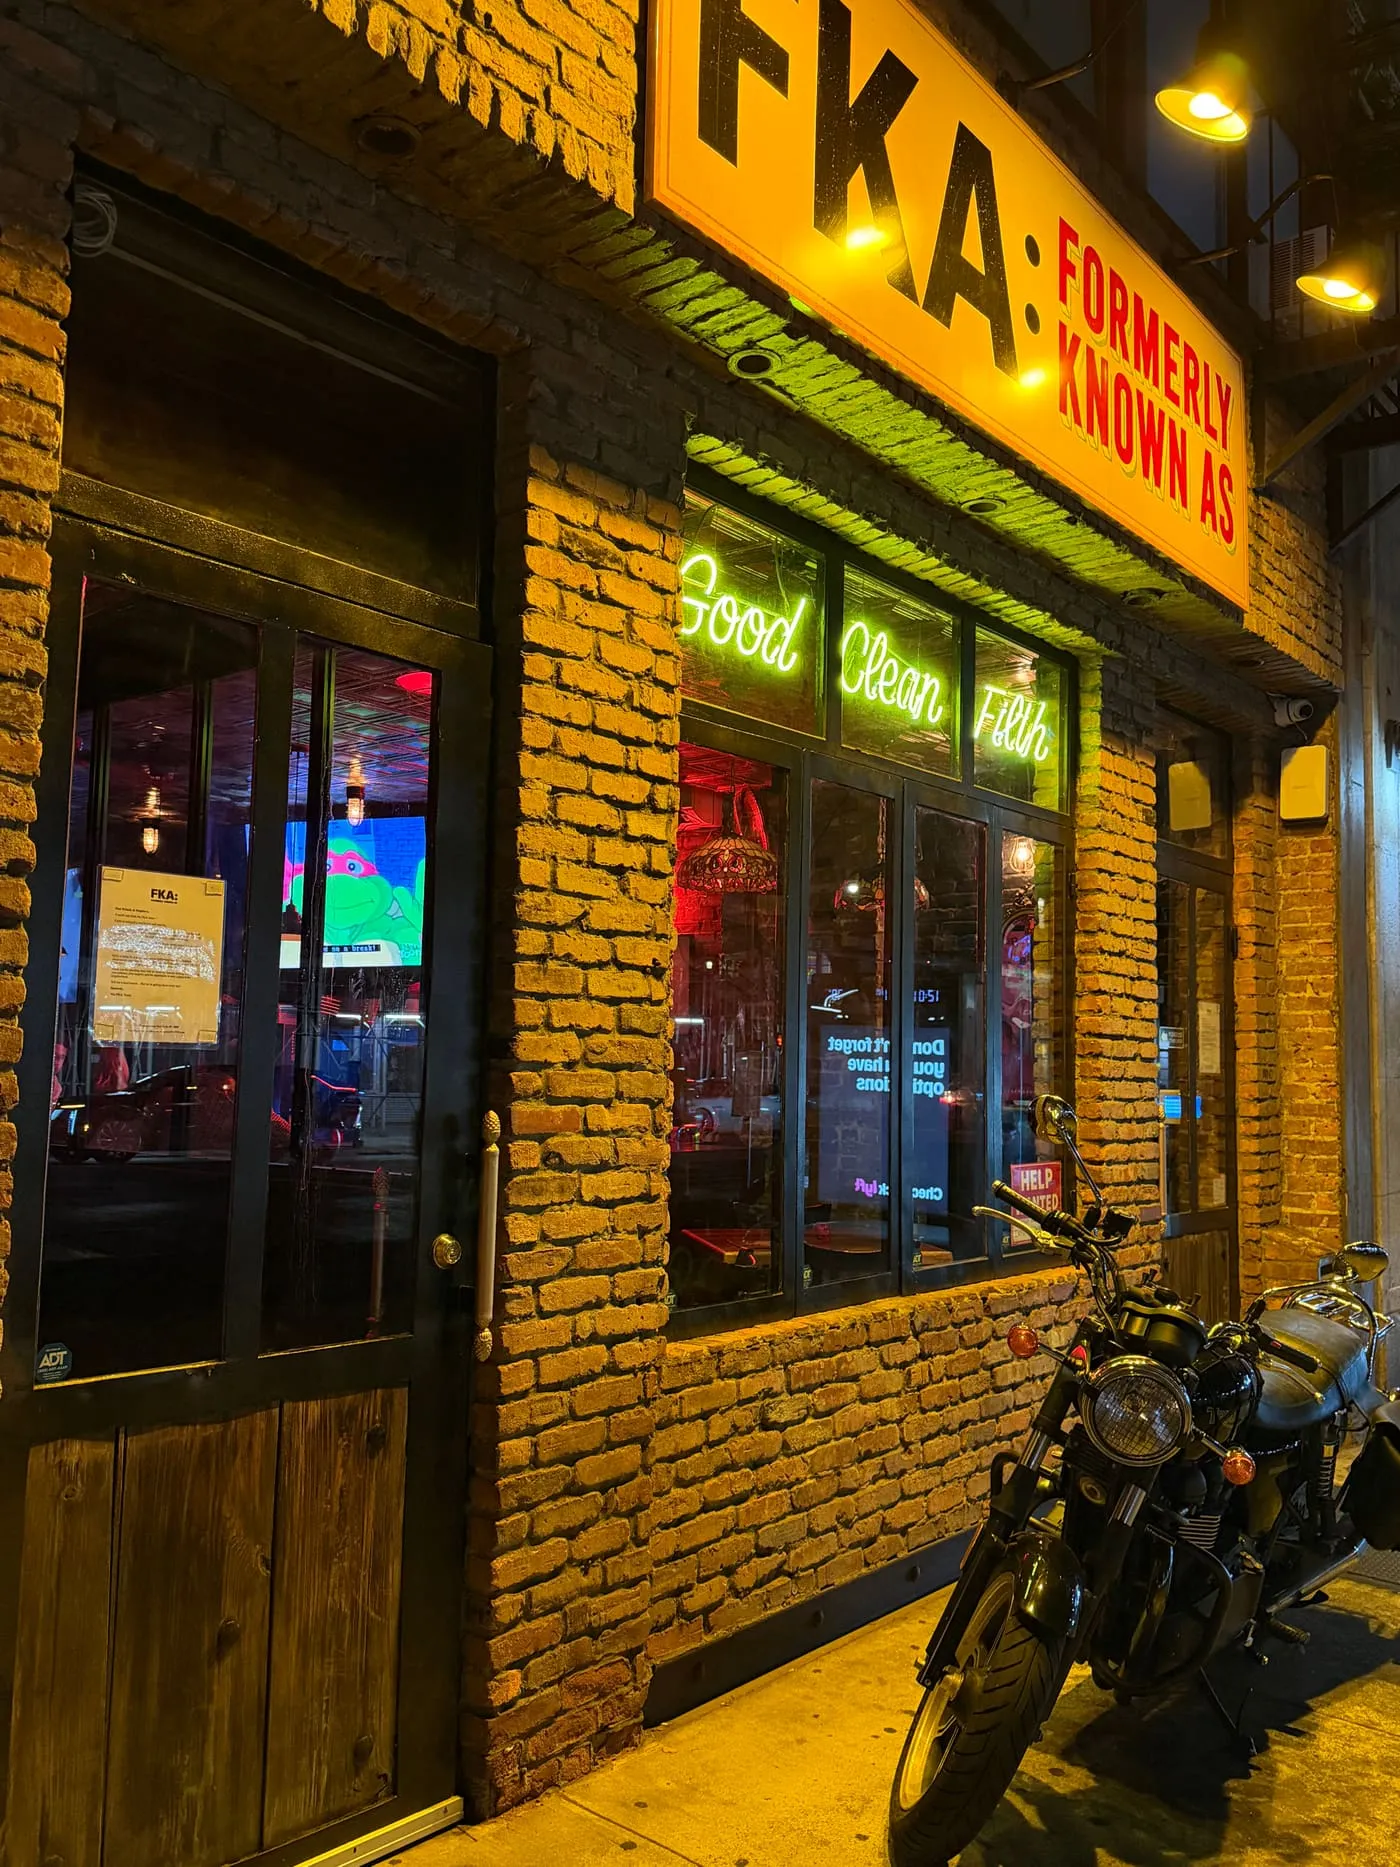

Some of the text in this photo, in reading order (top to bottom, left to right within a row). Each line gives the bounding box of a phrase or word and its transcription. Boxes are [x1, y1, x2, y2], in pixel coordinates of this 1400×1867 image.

[1058, 216, 1234, 451] FORMERLY
[1058, 321, 1234, 546] KNOWN AS
[680, 552, 1050, 762] Good Clean Filth
[150, 887, 179, 901] FKA:
[1021, 1167, 1054, 1192] HELP
[38, 1350, 68, 1369] ADT
